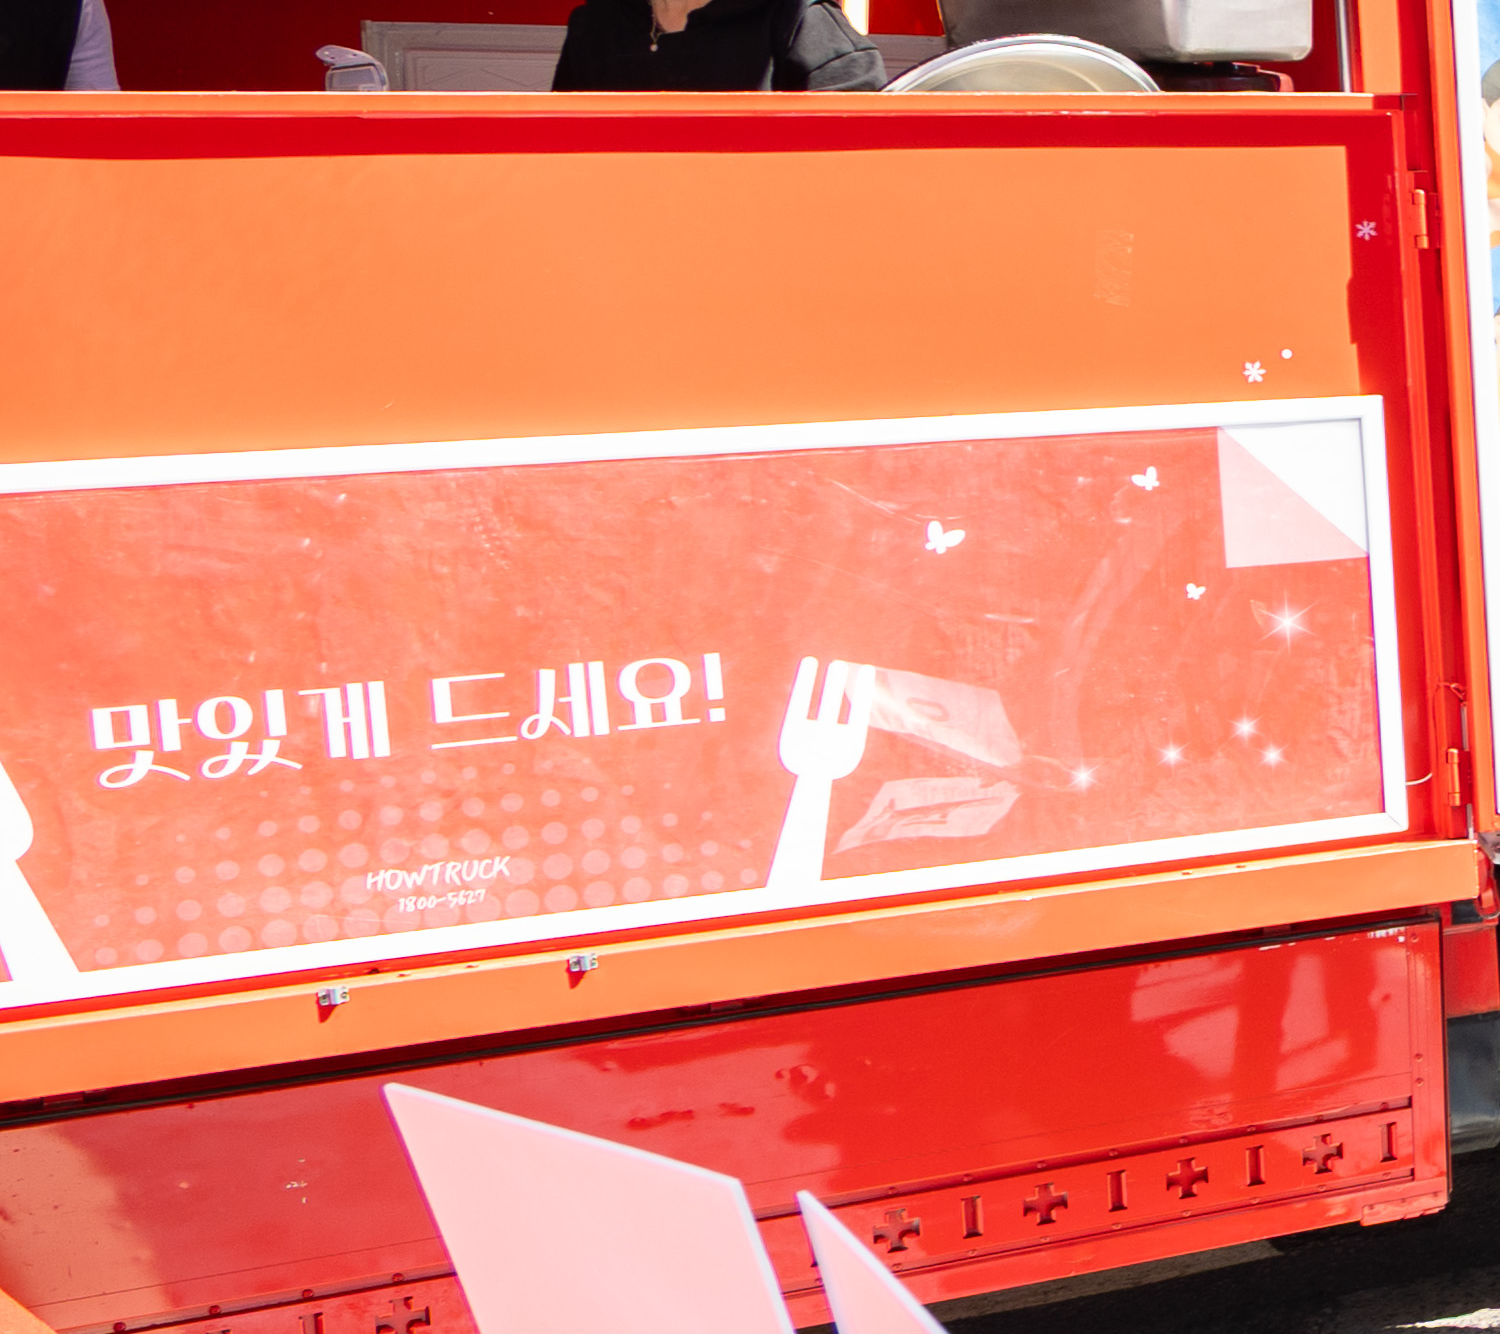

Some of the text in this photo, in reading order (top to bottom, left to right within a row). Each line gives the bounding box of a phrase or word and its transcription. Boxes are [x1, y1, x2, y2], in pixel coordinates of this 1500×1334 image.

[90, 652, 728, 790] 맛있게 드세요!
[366, 854, 512, 893] HOWTRUCK
[397, 889, 487, 915] 1800-5627
